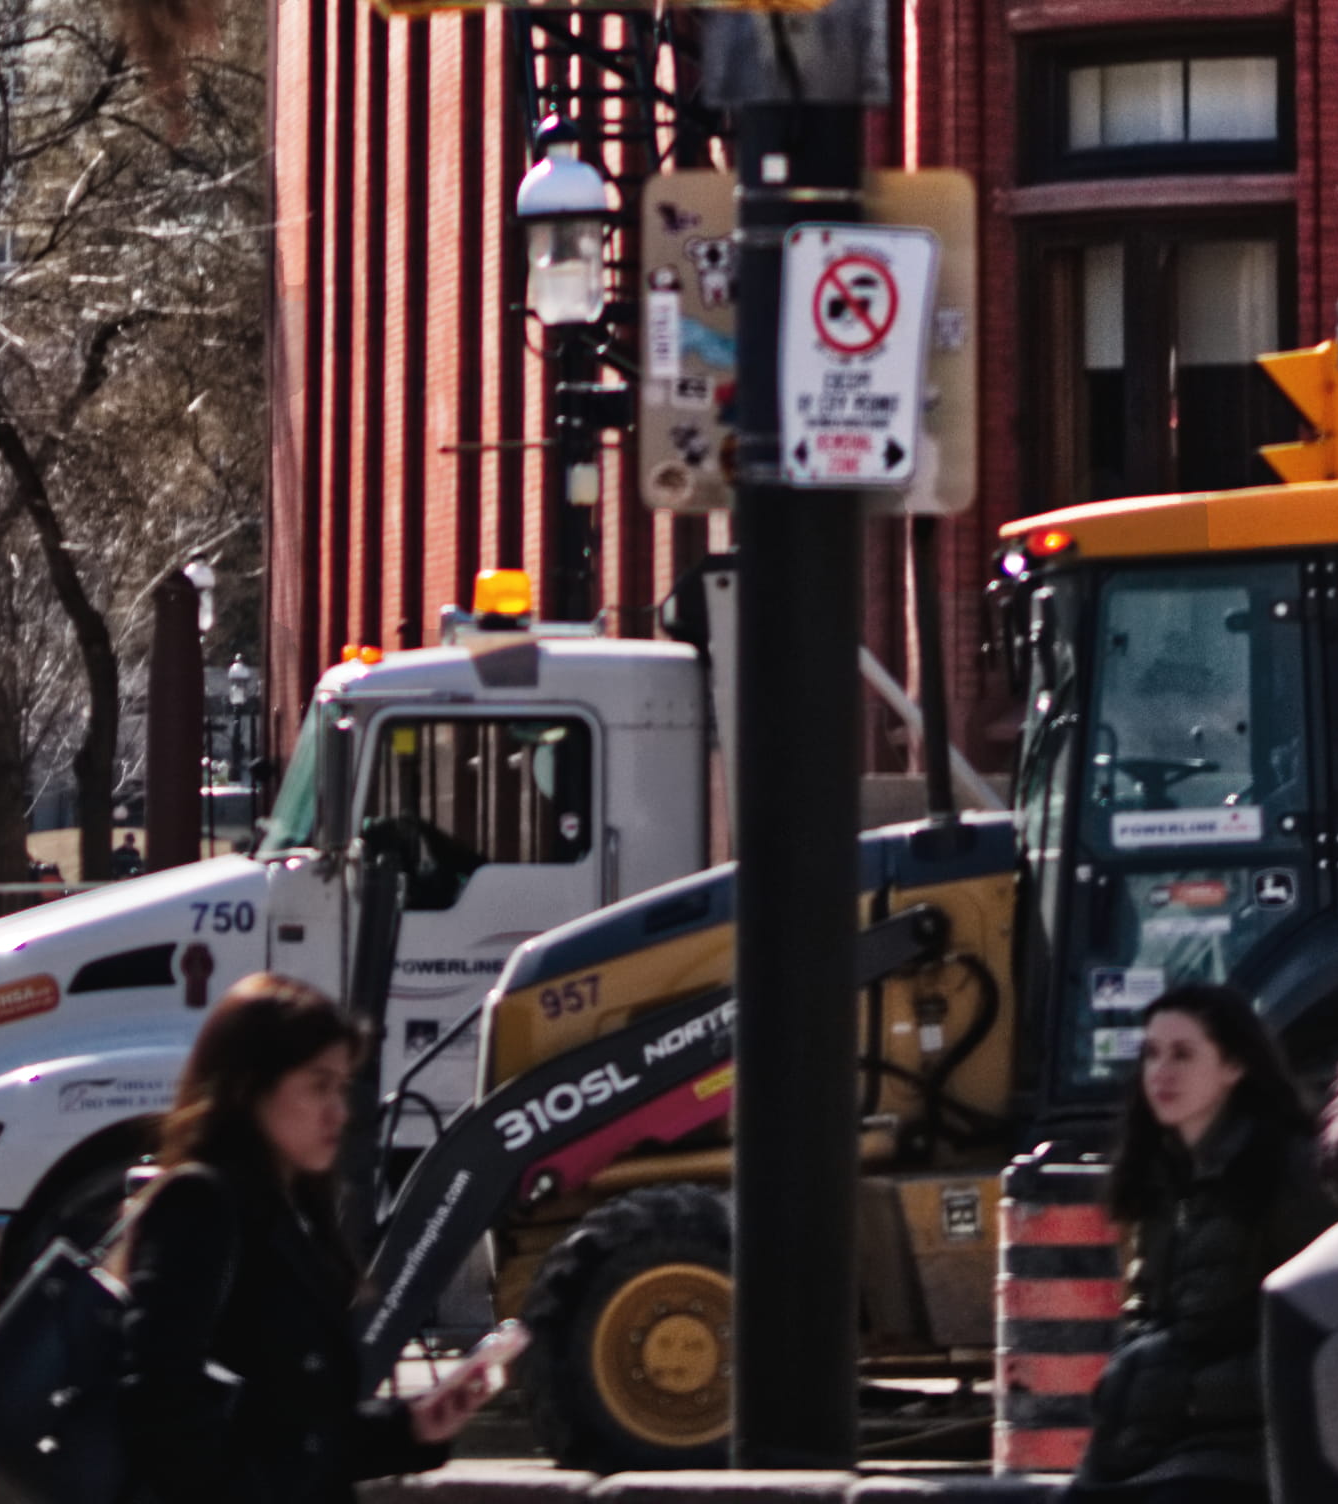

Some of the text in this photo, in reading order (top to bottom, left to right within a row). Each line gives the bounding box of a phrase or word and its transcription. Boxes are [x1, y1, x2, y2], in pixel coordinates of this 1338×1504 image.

[190, 901, 256, 934] 750
[539, 974, 601, 1020] 957
[494, 1062, 642, 1151] 310SL
